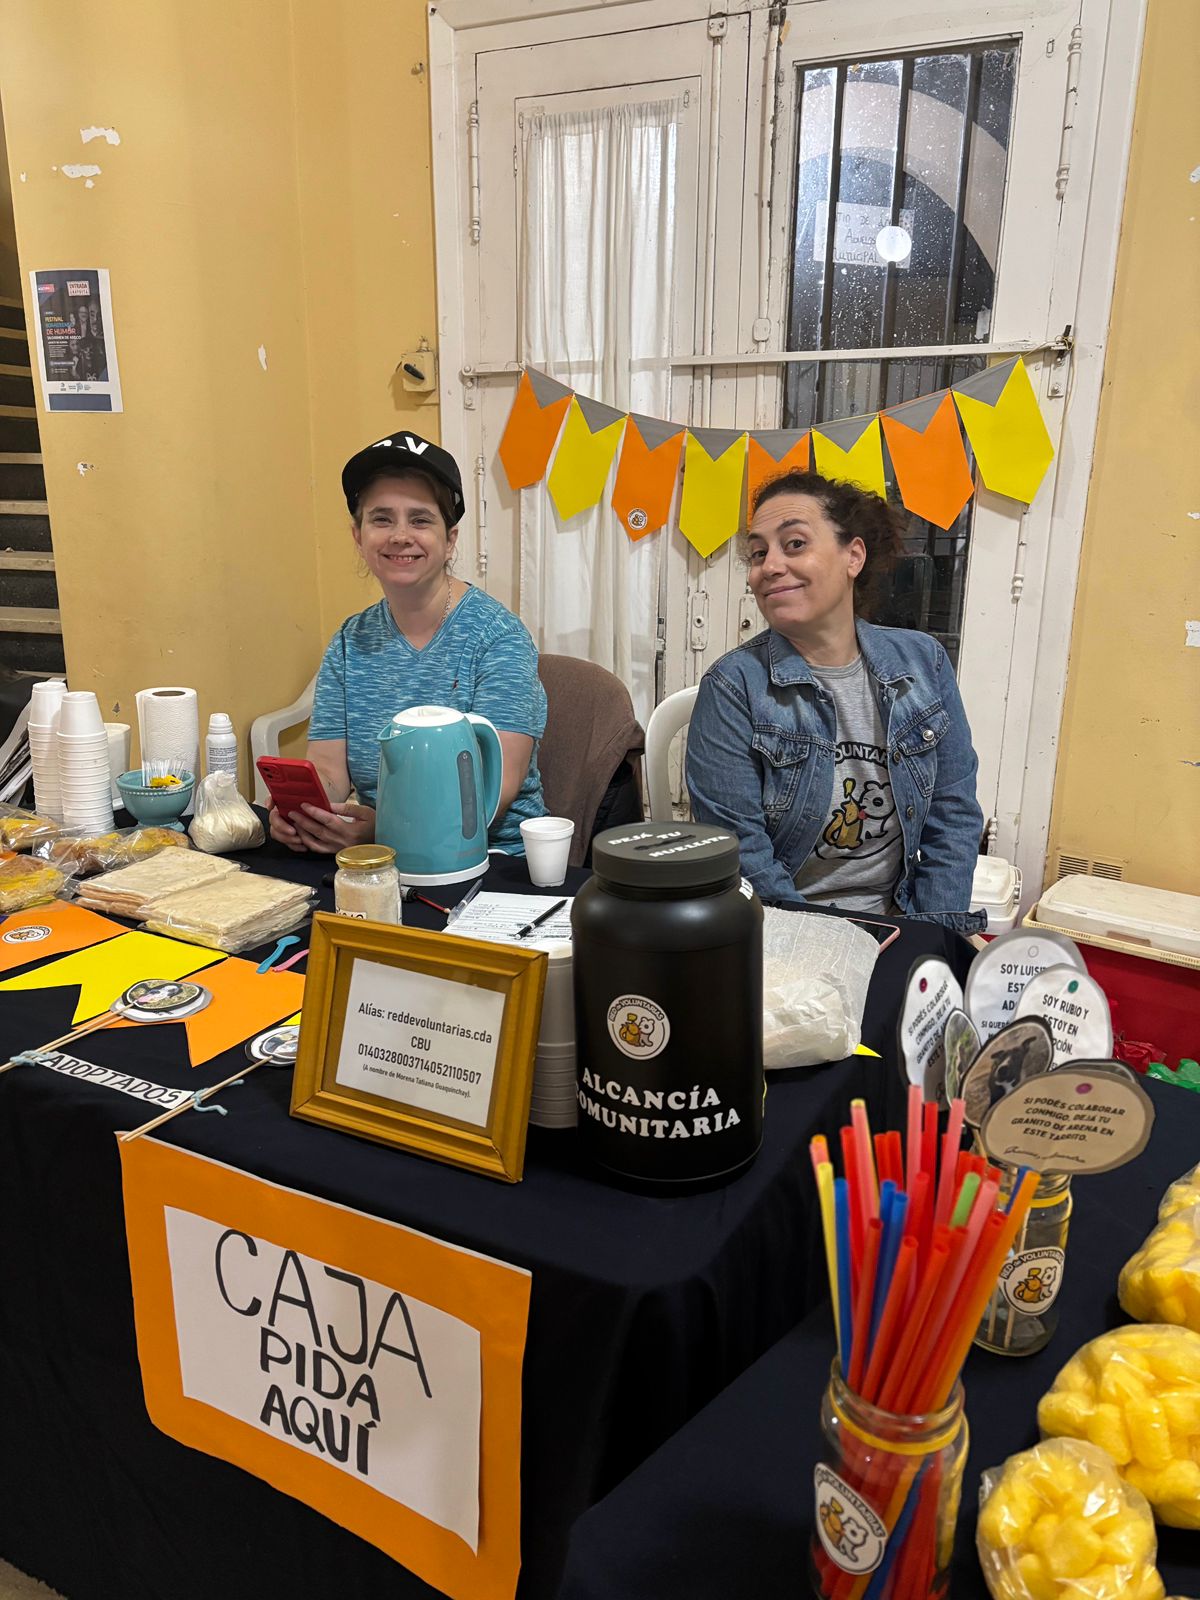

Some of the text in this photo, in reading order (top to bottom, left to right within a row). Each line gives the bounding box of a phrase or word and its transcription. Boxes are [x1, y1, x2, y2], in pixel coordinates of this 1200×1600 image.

[46, 328, 76, 336] DE HUMOR
[656, 831, 682, 840] TU
[649, 835, 731, 858] HUELLITA
[1000, 964, 1018, 975] SOY
[1008, 982, 1025, 993] EST
[1002, 1000, 1017, 1011] AD
[1042, 994, 1089, 1020] SOY RUBIO Y
[387, 1009, 492, 1044] reddevoluntarias.cda
[1067, 1023, 1079, 1037] EN
[411, 1035, 431, 1051] CBU
[358, 1043, 481, 1085] 0140328003714052110507
[46, 1053, 182, 1104] ADOPTADOS
[369, 1066, 388, 1076] nombre
[389, 1070, 395, 1078] de
[396, 1072, 415, 1083] Morena
[582, 1067, 721, 1111] ALCANCÍA
[1024, 1097, 1126, 1116] SI PODÉS COLABORAR
[1011, 1117, 1115, 1137] GRANITO DE ARENA EN
[1098, 1115, 1111, 1124] TU
[1023, 1127, 1048, 1139] ESTE
[215, 1229, 432, 1398] CAJA
[260, 1326, 380, 1422] PIDA
[260, 1384, 377, 1475] AQUÍ
